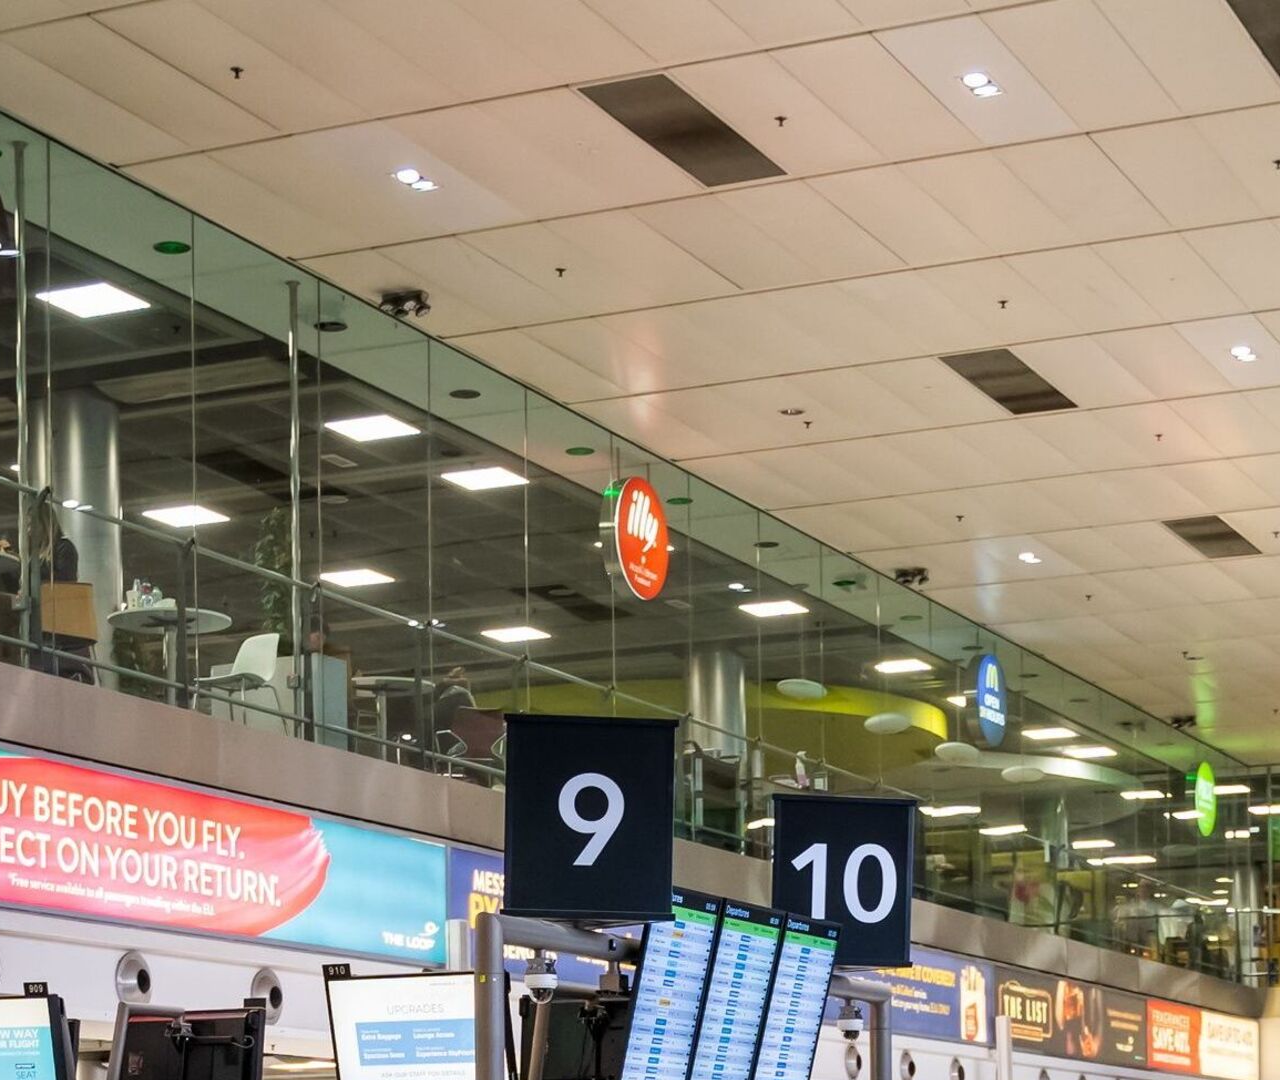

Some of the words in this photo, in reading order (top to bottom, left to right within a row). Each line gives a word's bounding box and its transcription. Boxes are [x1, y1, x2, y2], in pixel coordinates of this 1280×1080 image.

[984, 693, 1000, 710] OPEN
[33, 785, 139, 840] BEFORE
[142, 808, 196, 849] YOU
[202, 819, 246, 860] FLY.
[558, 772, 626, 867] 9
[56, 837, 100, 877] ON
[104, 845, 178, 891] YOUR
[792, 842, 898, 925] 10
[382, 931, 406, 947] THE
[406, 936, 437, 950] LOOP
[328, 966, 346, 975] 910
[28, 984, 44, 993] 909
[386, 1003, 445, 1016] UPGRADES
[1003, 994, 1022, 1020] THE
[1025, 999, 1048, 1025] LIST
[13, 1029, 39, 1039] WAY
[8, 1039, 40, 1049] FLIGHT
[15, 1071, 37, 1080] SEAT
